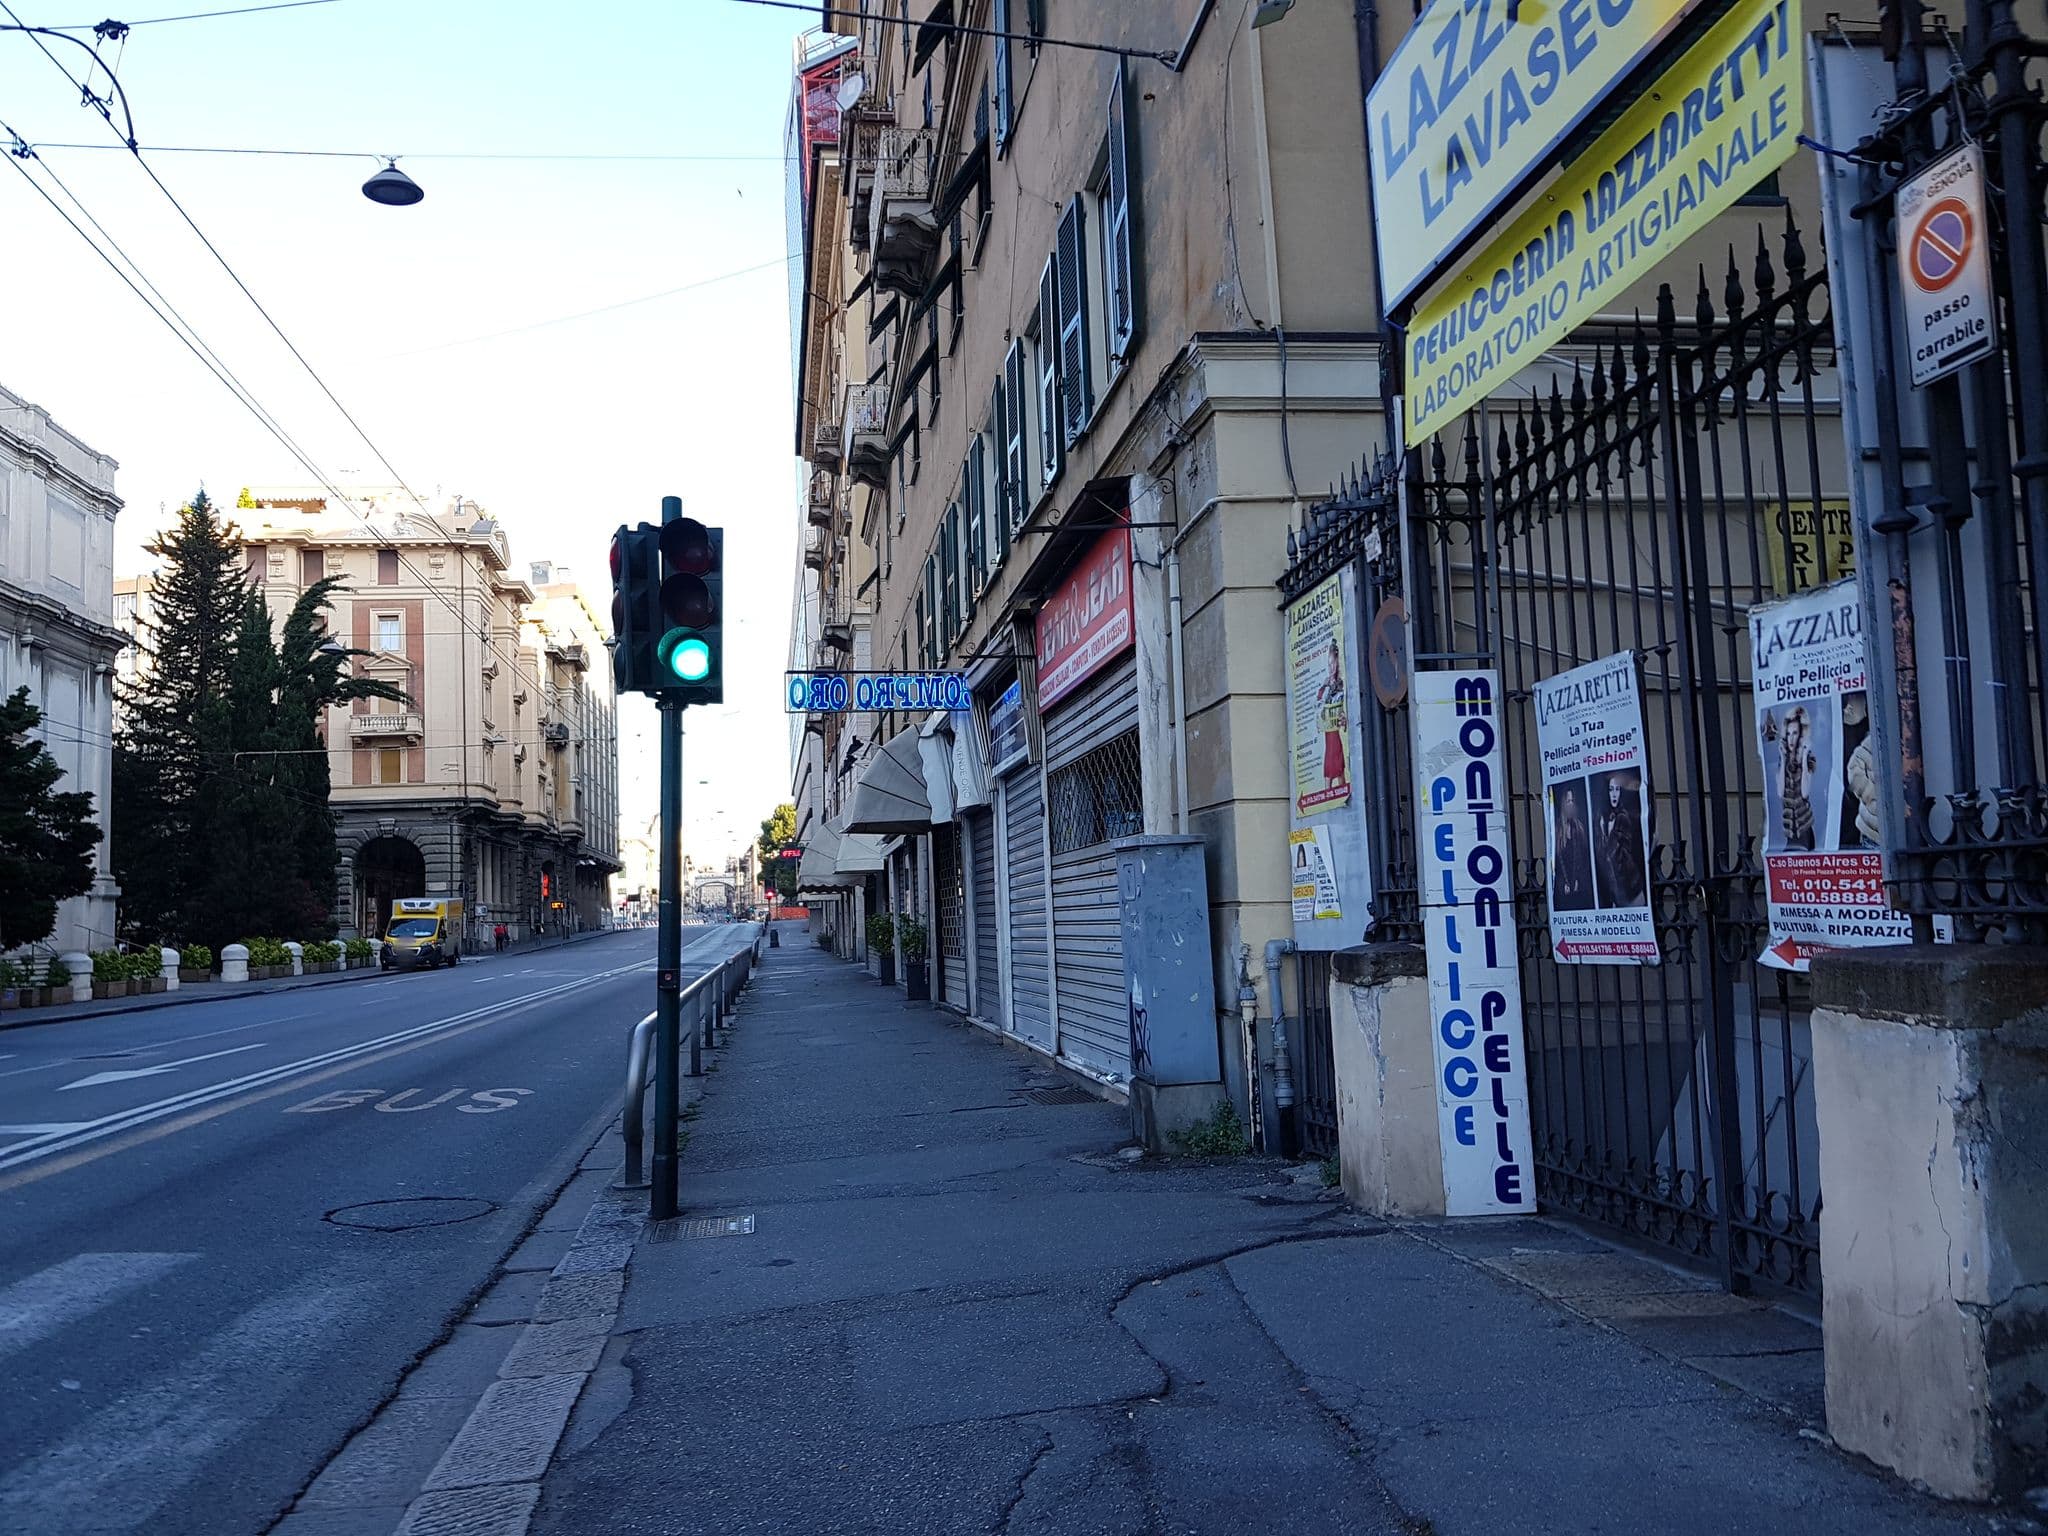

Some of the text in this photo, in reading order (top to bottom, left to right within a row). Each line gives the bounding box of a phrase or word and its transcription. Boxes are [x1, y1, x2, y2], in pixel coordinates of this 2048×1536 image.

[1413, 0, 1789, 378] PELLICCERIA LAZZARETTI
[1927, 162, 1974, 198] GENOVA
[1414, 83, 1788, 427] LABORATORIO ARTIGIANALE
[1924, 294, 1970, 332] passo
[1916, 318, 1985, 362] carrabile
[1293, 581, 1339, 626] LAZZARETTI
[1298, 605, 1334, 637] LAVASECCO
[1758, 679, 1772, 692] La
[1799, 661, 1851, 683] Pelliccia
[1535, 667, 1631, 727] LAZZARETTI
[1777, 682, 1831, 701] Diventa
[1569, 721, 1605, 737] La Tua
[1544, 744, 1581, 762] Pelliccia
[1549, 761, 1582, 778] Diventa
[1769, 855, 1880, 868] C.so Buenos Aires 62
[1780, 879, 1884, 891] Tel. 010.541
[1553, 915, 1588, 925] PULITURA
[1594, 912, 1649, 924] RIPARAZIONE
[1780, 907, 1821, 919] RIMESSA
[1824, 908, 1834, 919] A
[1560, 926, 1641, 937] RIMESSA A MODELLO
[1773, 922, 1820, 933] PULITURA
[1431, 776, 1479, 1146] PELLICCE
[1796, 945, 1812, 957] Tel.
[282, 1087, 536, 1113] BUS
[1480, 990, 1523, 1204] PELLE
